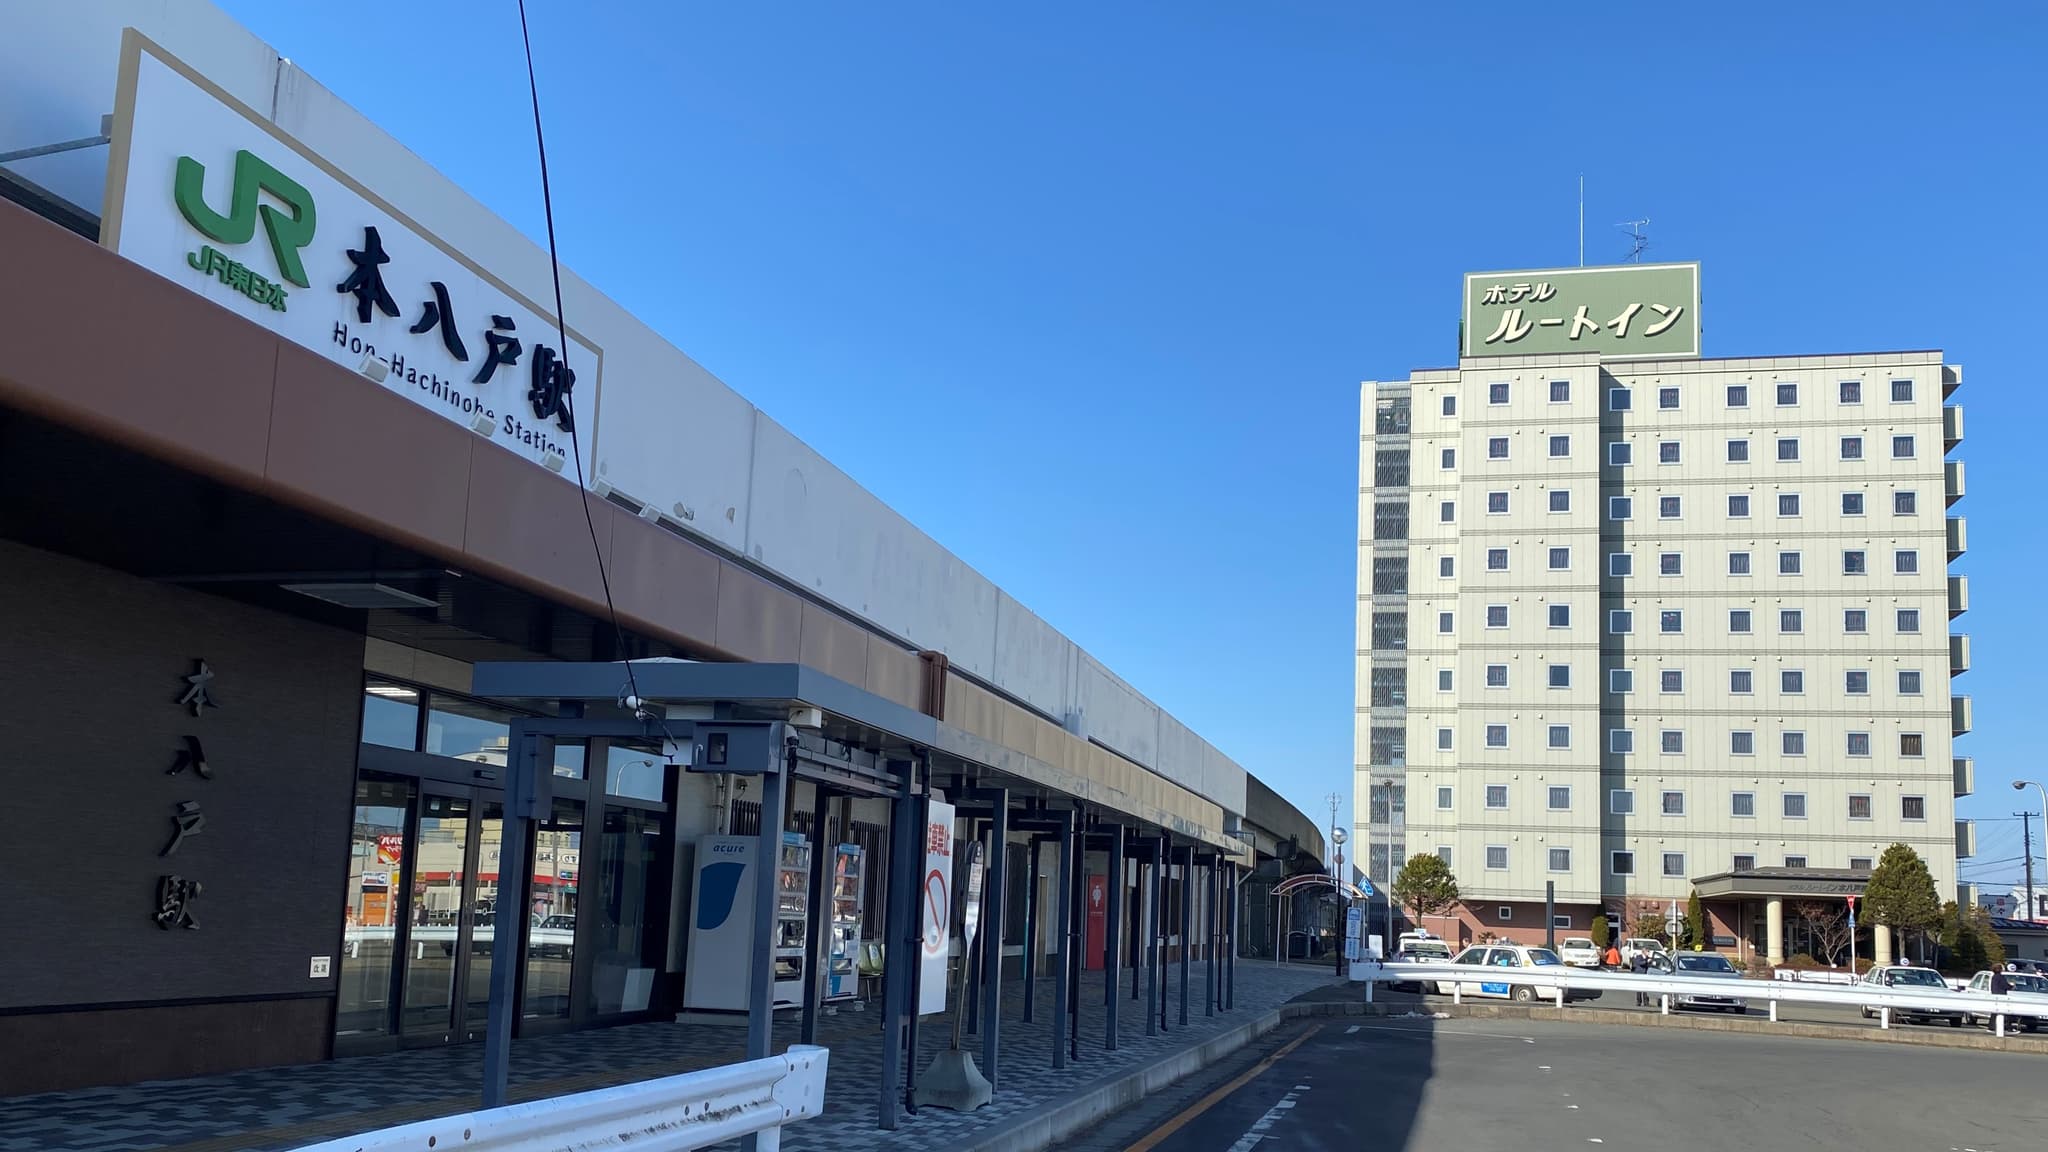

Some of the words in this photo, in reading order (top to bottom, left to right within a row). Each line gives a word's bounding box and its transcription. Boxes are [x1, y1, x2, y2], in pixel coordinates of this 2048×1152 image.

[174, 149, 317, 288] JR
[187, 244, 288, 312] JR東日本
[336, 226, 576, 433] 本八戸駅
[1481, 282, 1557, 305] ホテル
[1485, 303, 1684, 345] ルートイン
[333, 319, 495, 418] Hon-Hachinohe
[503, 414, 566, 457] Station
[151, 658, 219, 931] 本八戸駅
[713, 844, 745, 853] acure
